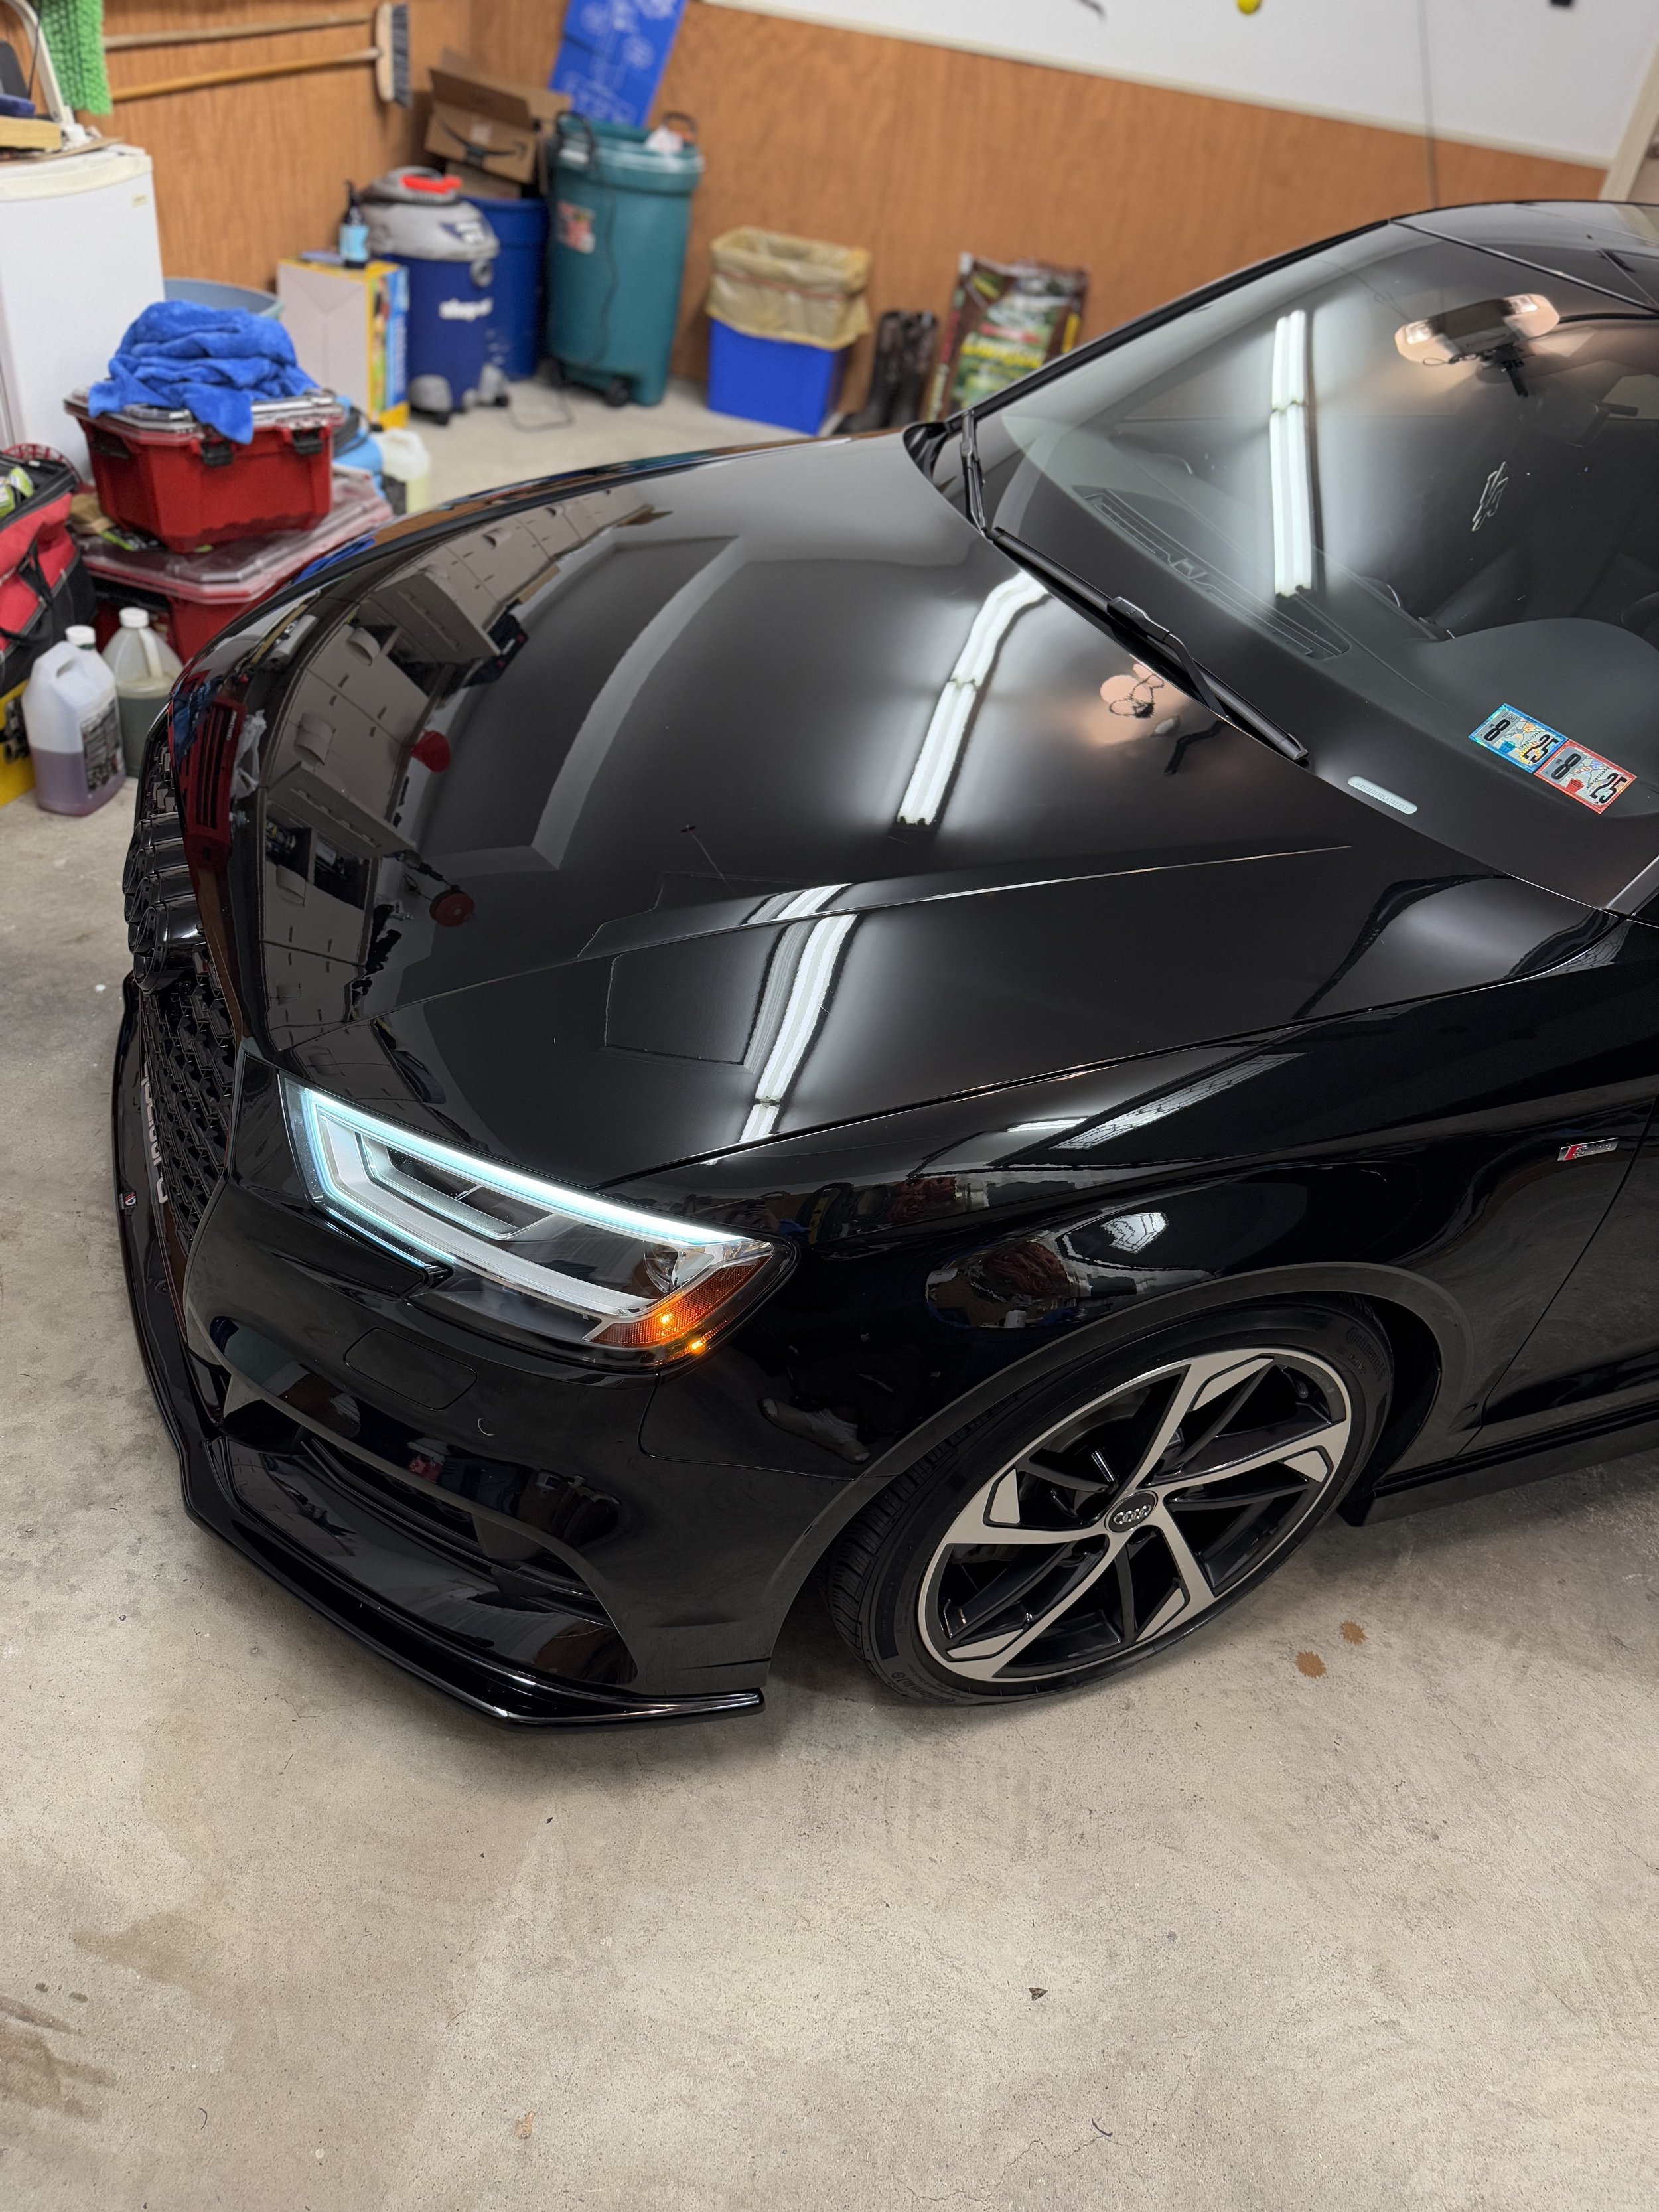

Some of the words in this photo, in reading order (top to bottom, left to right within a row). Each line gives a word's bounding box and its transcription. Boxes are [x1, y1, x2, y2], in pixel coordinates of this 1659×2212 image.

[1483, 719, 1511, 741] 8
[1524, 734, 1559, 763] 25
[1551, 753, 1582, 780] 8
[1589, 773, 1630, 804] 25
